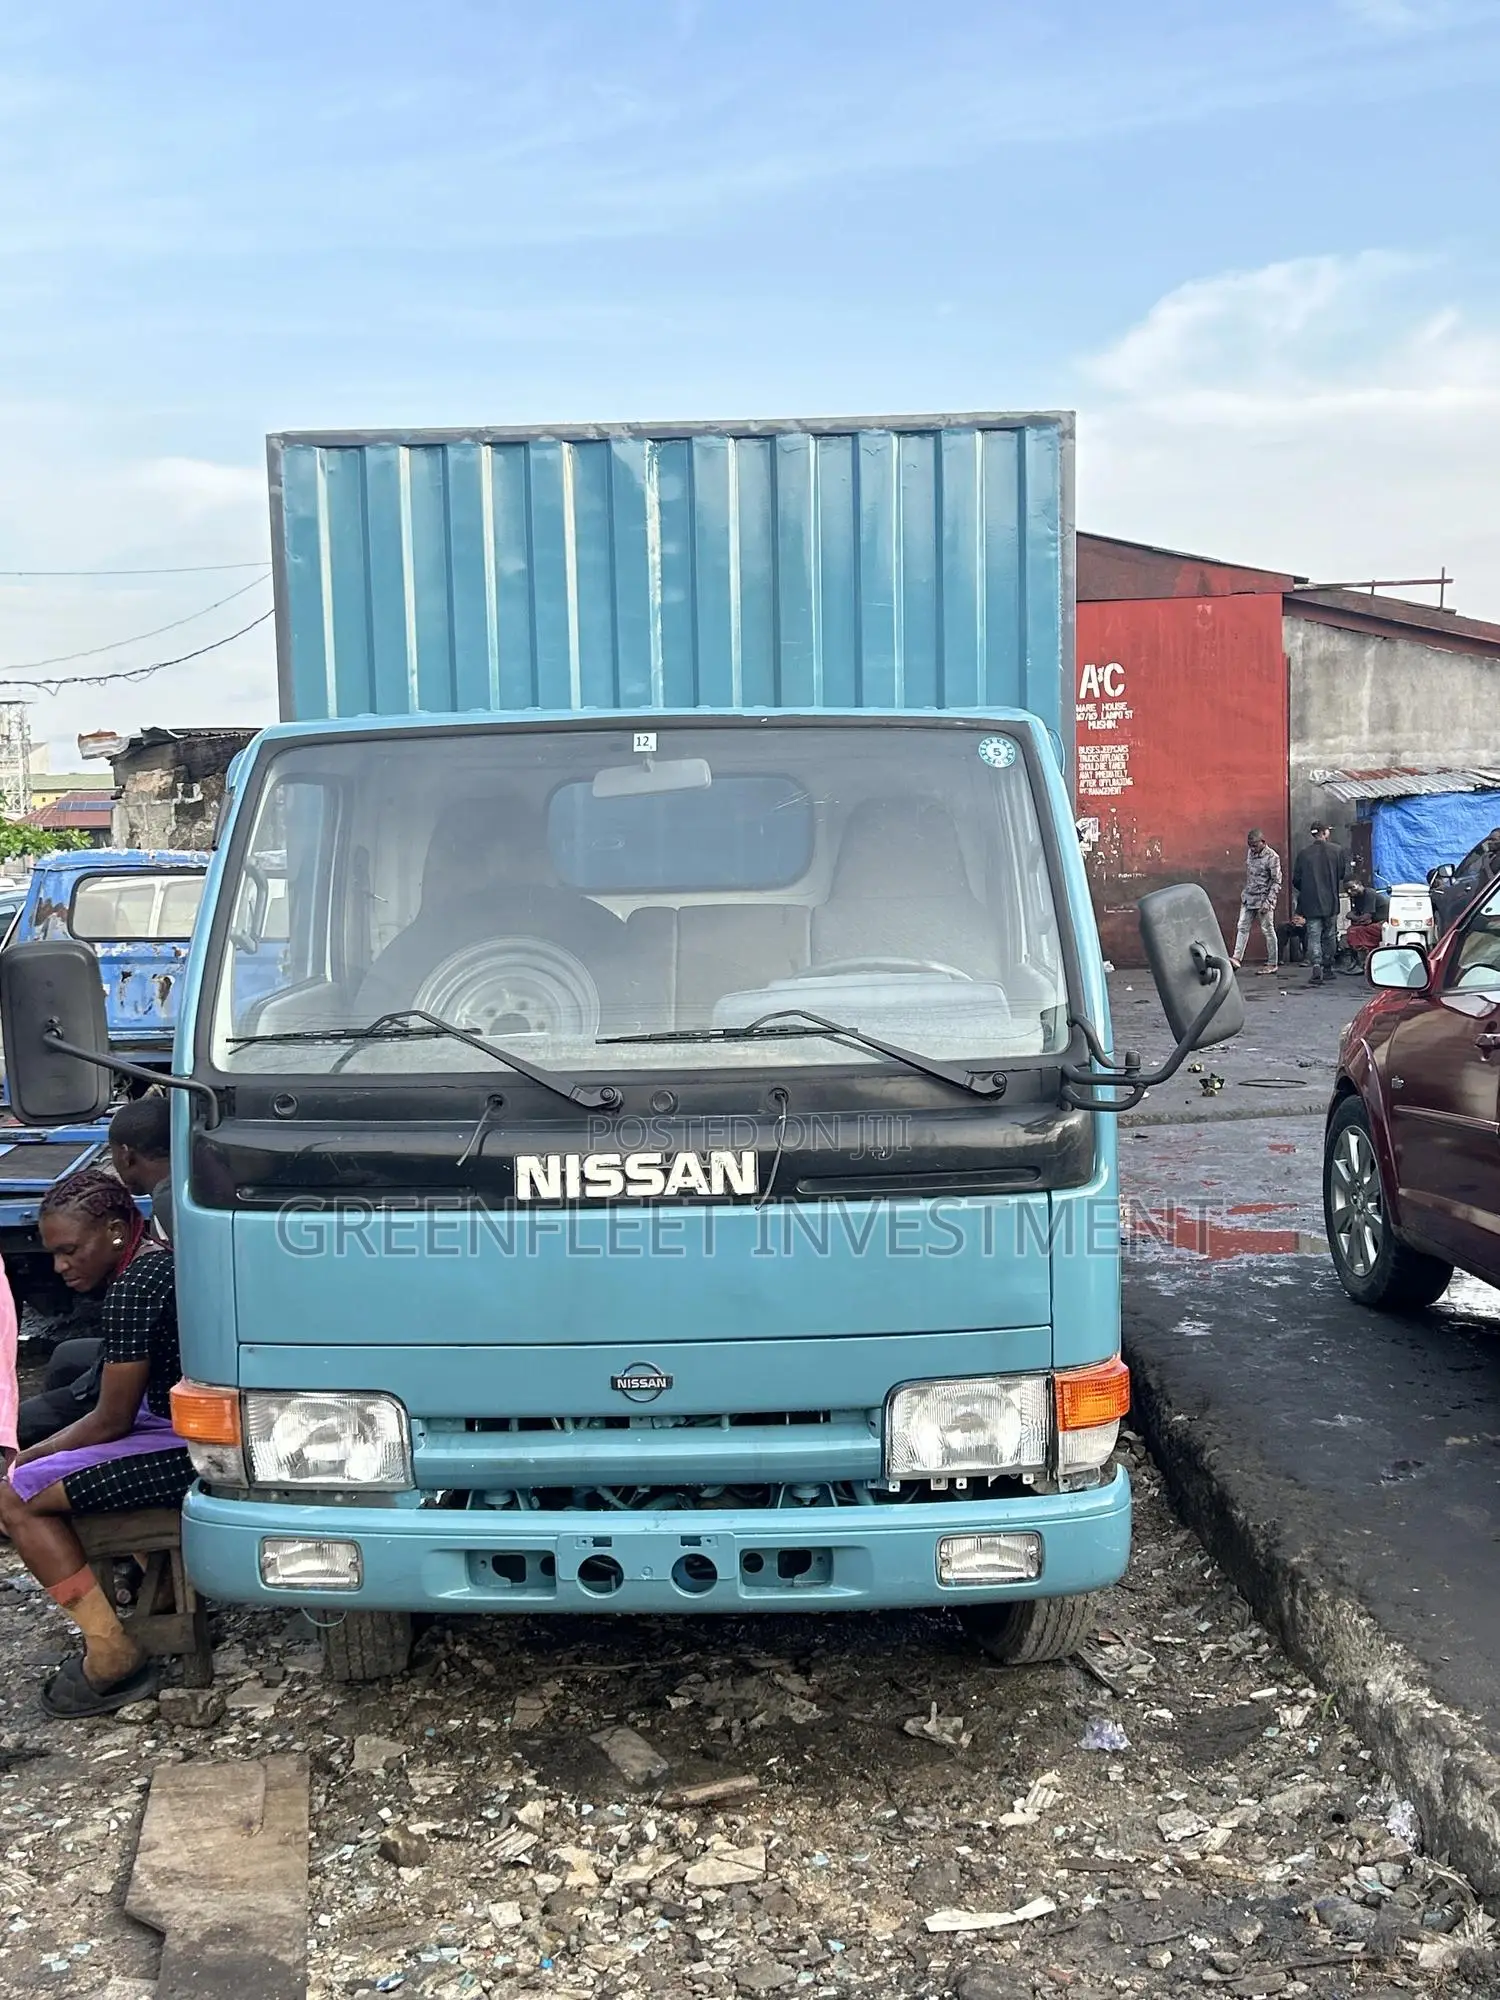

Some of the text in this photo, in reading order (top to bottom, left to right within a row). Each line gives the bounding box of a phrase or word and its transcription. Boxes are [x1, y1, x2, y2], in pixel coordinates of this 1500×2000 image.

[1101, 701, 1128, 711] HOUSE
[1124, 710, 1134, 719] ST
[993, 747, 1002, 757] 5
[1078, 762, 1100, 771] SHOULD
[514, 1150, 760, 1201] NISSAN
[617, 1377, 667, 1389] NISSAN
